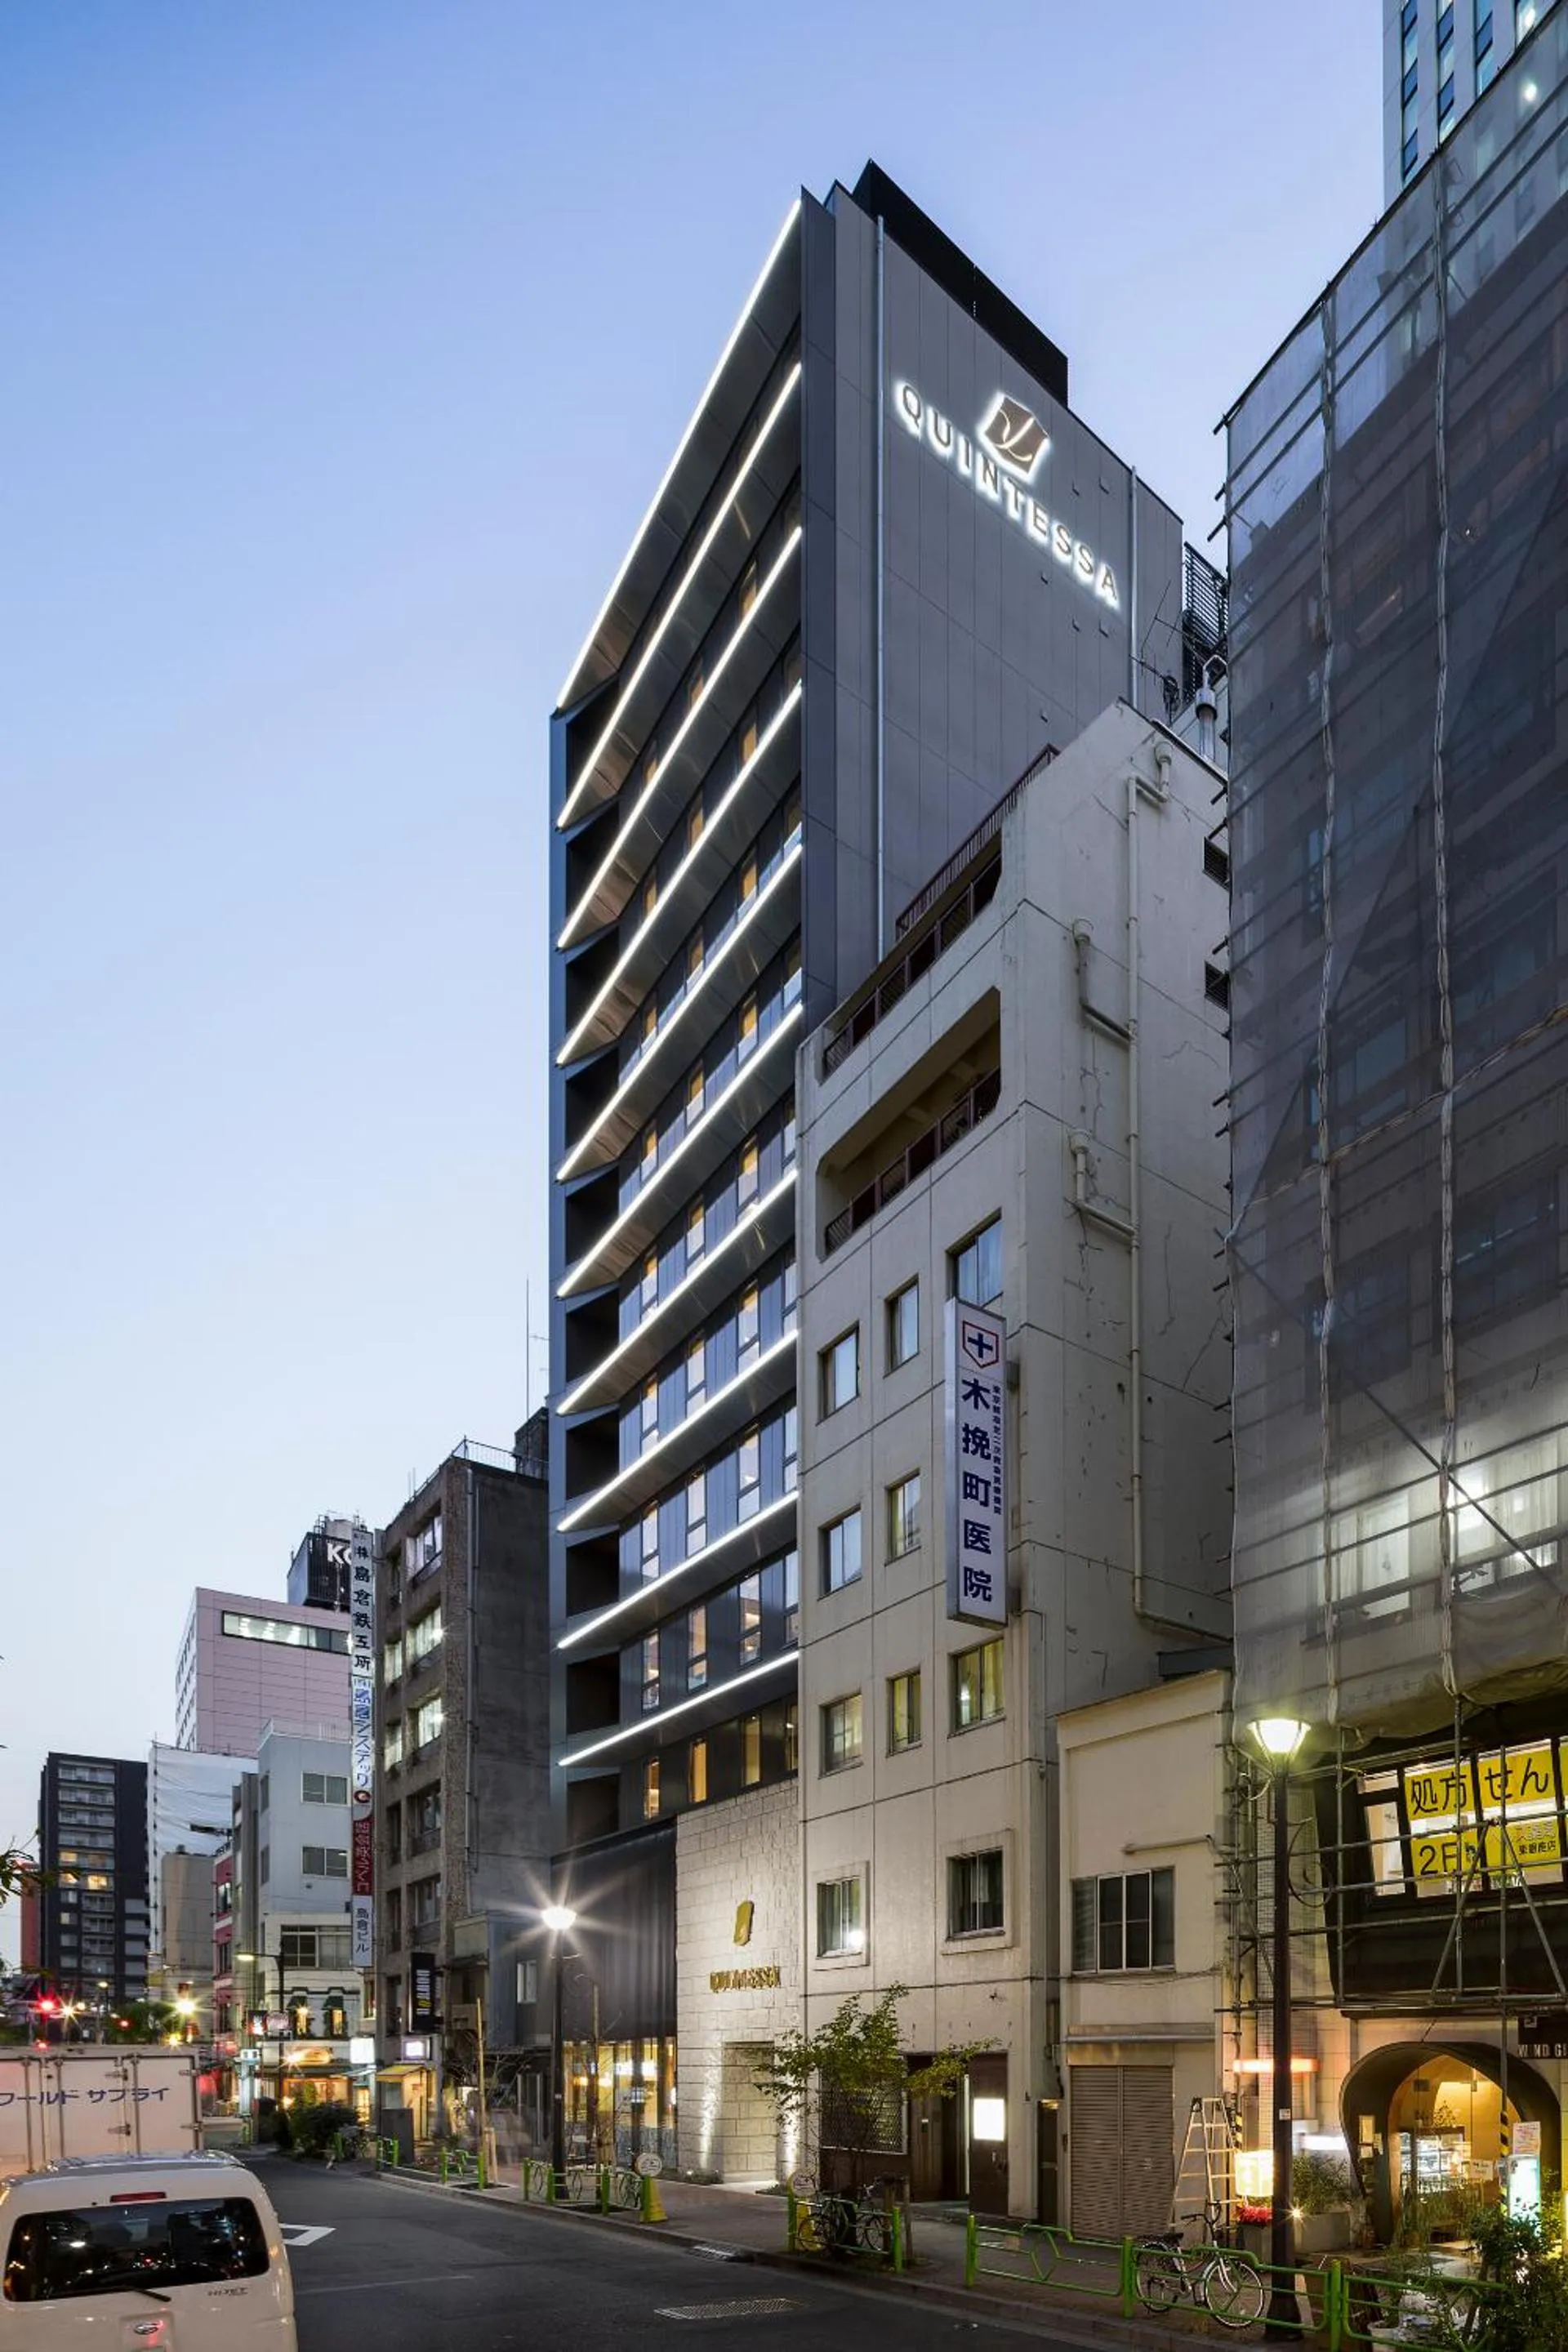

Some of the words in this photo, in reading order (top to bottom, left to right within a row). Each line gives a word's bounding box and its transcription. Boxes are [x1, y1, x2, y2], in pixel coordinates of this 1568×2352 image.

[897, 381, 1120, 609] QUINTESSA
[961, 1377, 992, 1603] 木挽町医院
[1410, 1757, 1549, 1815] 処方せん
[1518, 2044, 1550, 2057] WND
